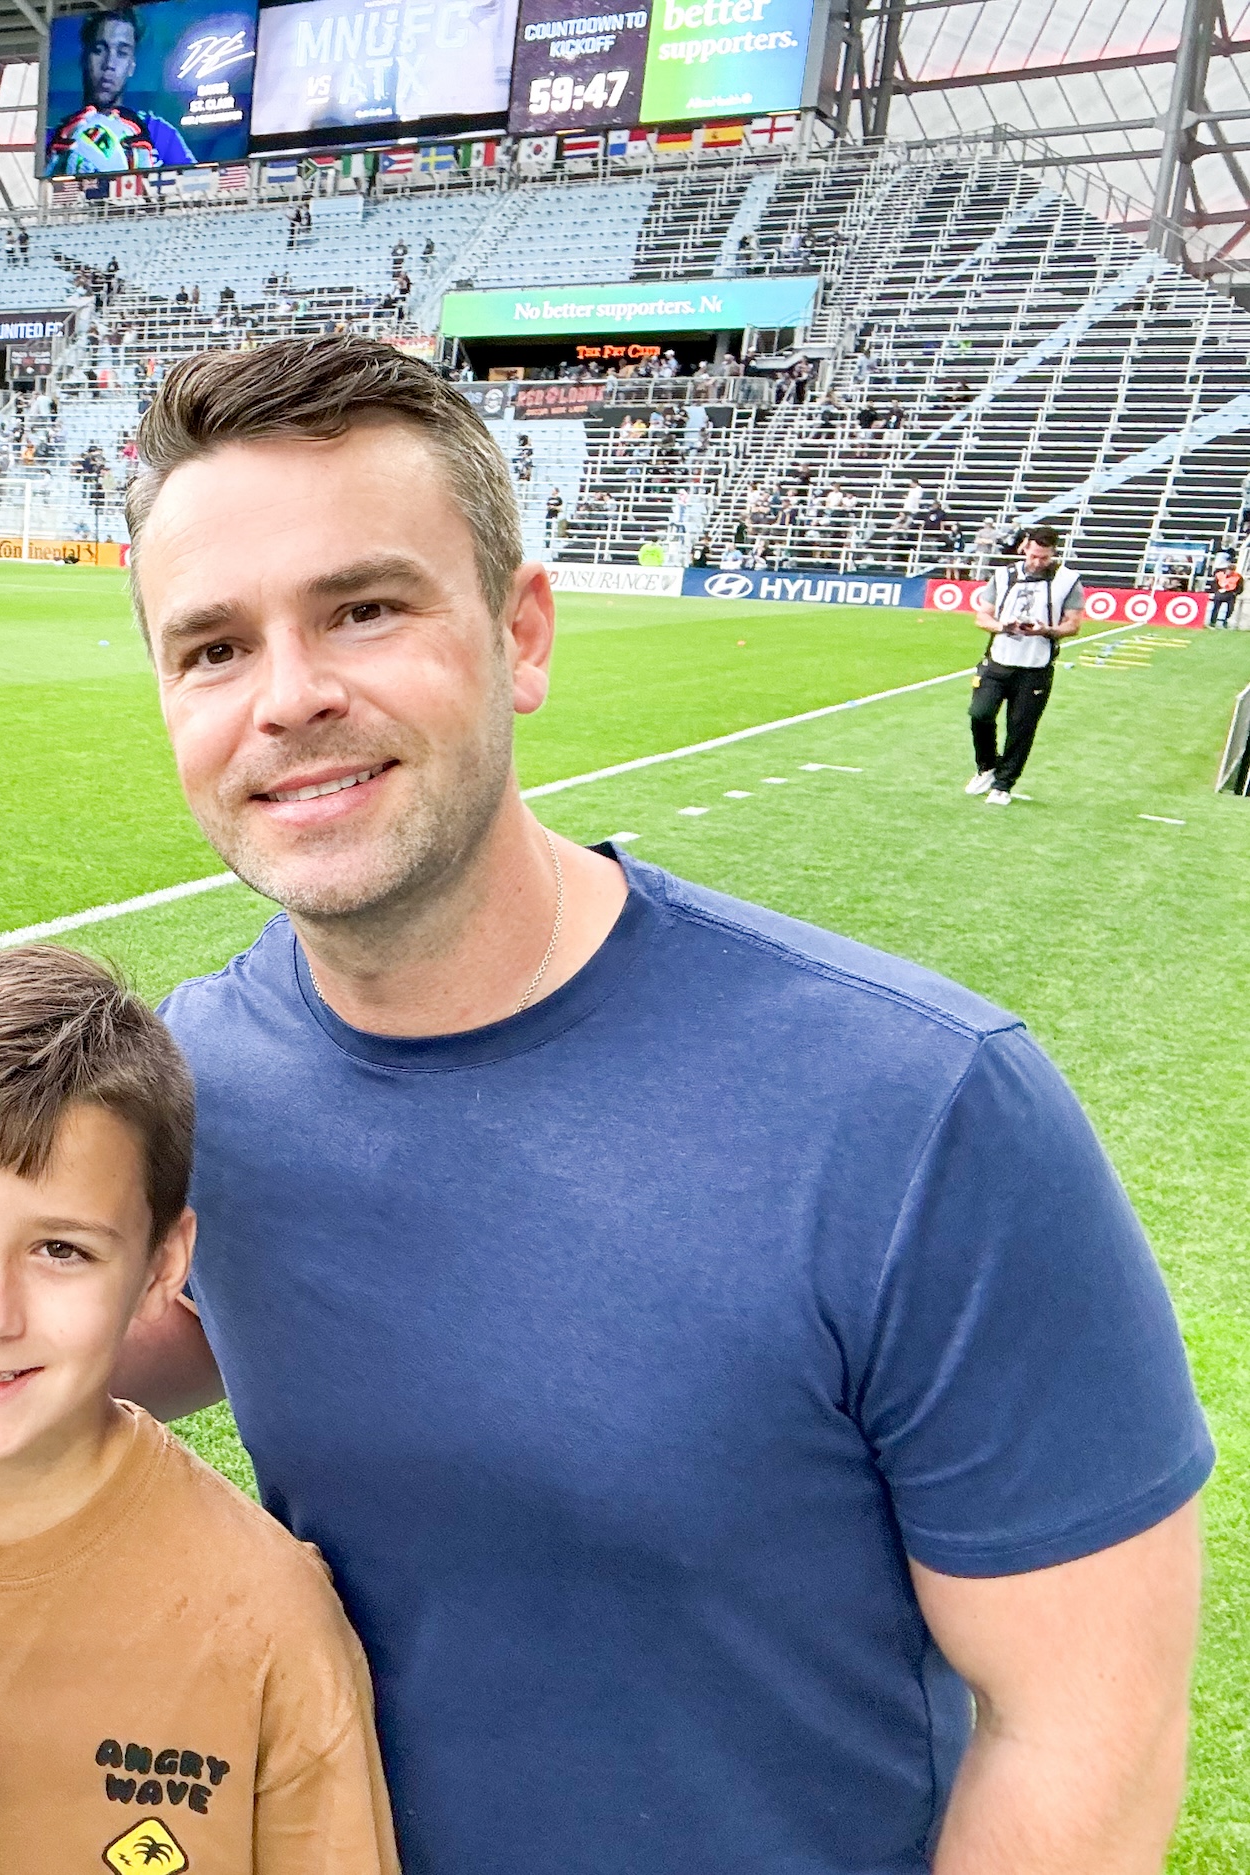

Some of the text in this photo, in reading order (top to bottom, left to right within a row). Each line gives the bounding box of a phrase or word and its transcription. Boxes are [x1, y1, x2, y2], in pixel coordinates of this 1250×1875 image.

[524, 10, 648, 41] COUNTDOWN TO
[662, 0, 771, 31] better
[550, 34, 616, 58] KICKOFF
[658, 30, 798, 65] supporters.
[307, 74, 332, 98] VS
[528, 70, 630, 114] 59:47
[513, 303, 540, 320] No
[542, 300, 595, 320] better
[596, 299, 696, 321] supporters.
[558, 570, 661, 591] INSURANCE
[760, 576, 902, 606] HYUNDAI
[95, 1739, 230, 1785] ANGRY
[105, 1773, 212, 1814] WAVE
